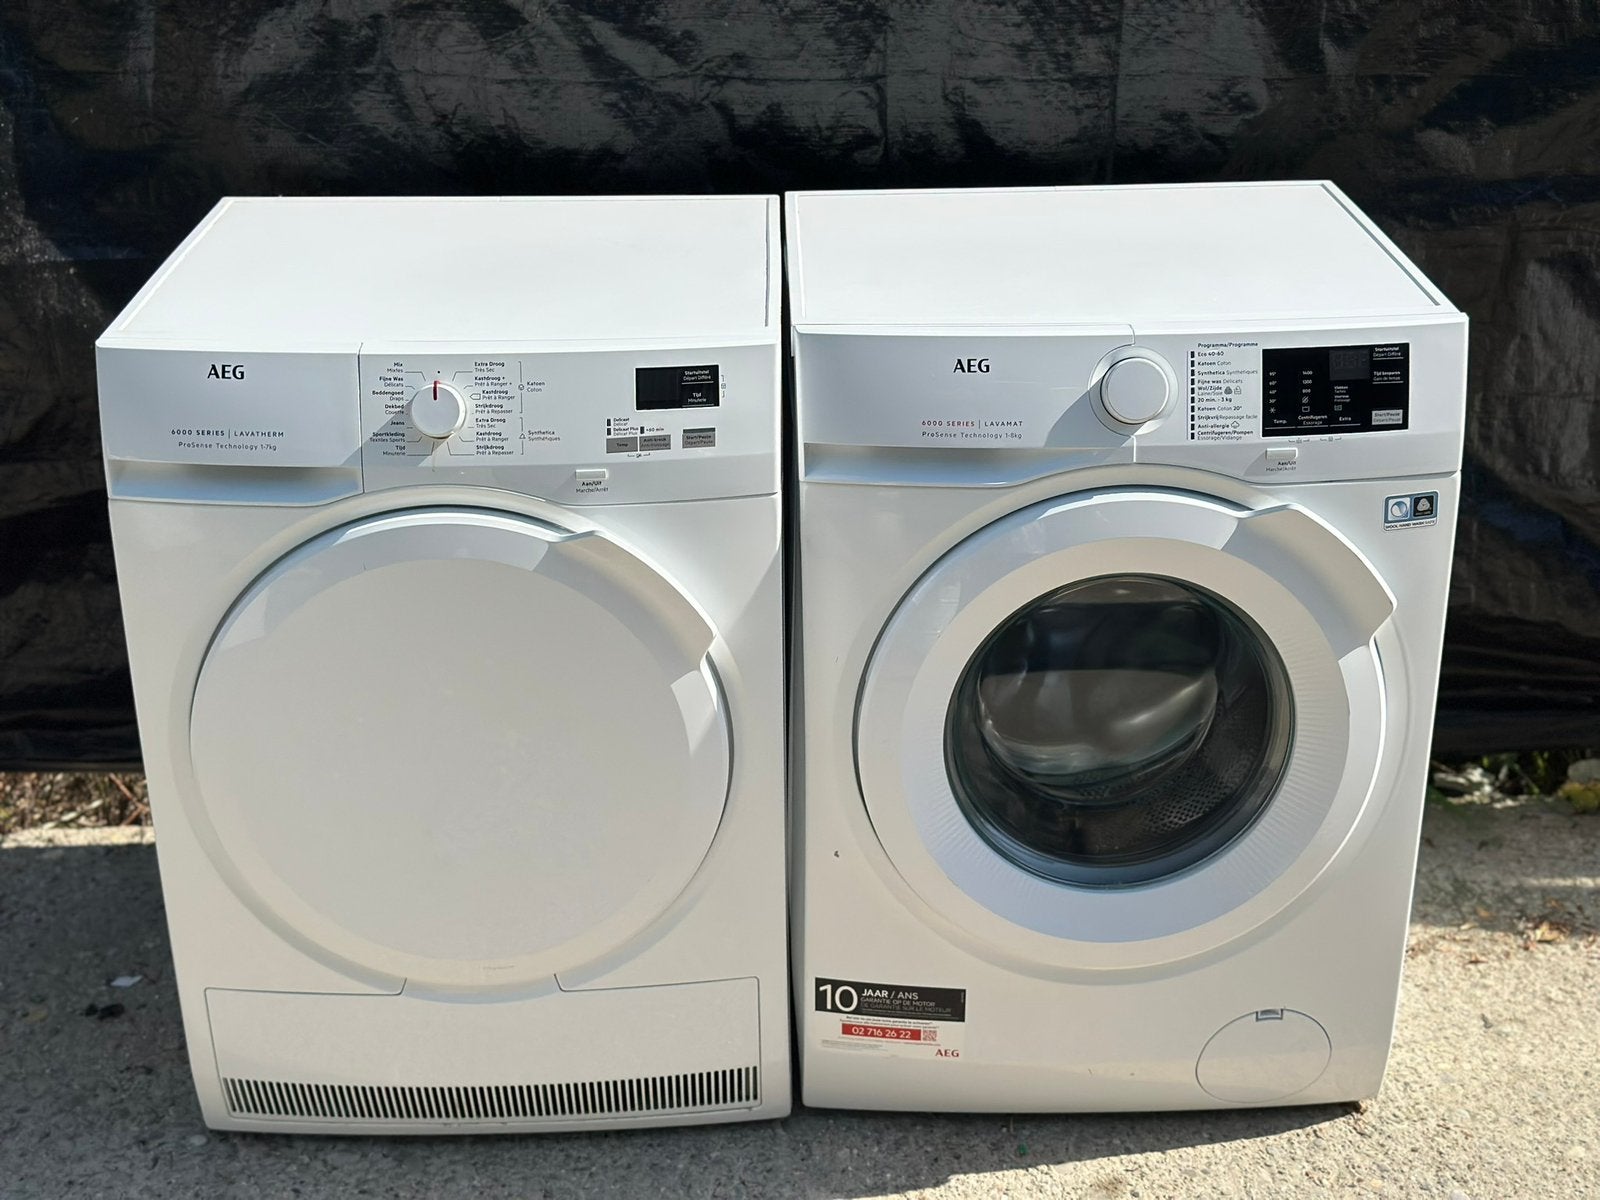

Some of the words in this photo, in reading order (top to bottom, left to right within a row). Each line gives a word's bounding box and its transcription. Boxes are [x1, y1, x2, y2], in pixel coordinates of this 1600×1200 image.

[207, 364, 244, 380] AEG
[953, 358, 990, 373] AEG
[216, 443, 258, 451] Technology
[819, 984, 858, 1012] 10
[862, 988, 889, 998] JAAR
[890, 991, 895, 999] /
[897, 991, 919, 1000] ANS
[852, 1026, 865, 1035] 02
[867, 1027, 883, 1037] 716
[885, 1029, 897, 1037] 26
[900, 1030, 911, 1039] 22
[935, 1049, 960, 1058] AEG
